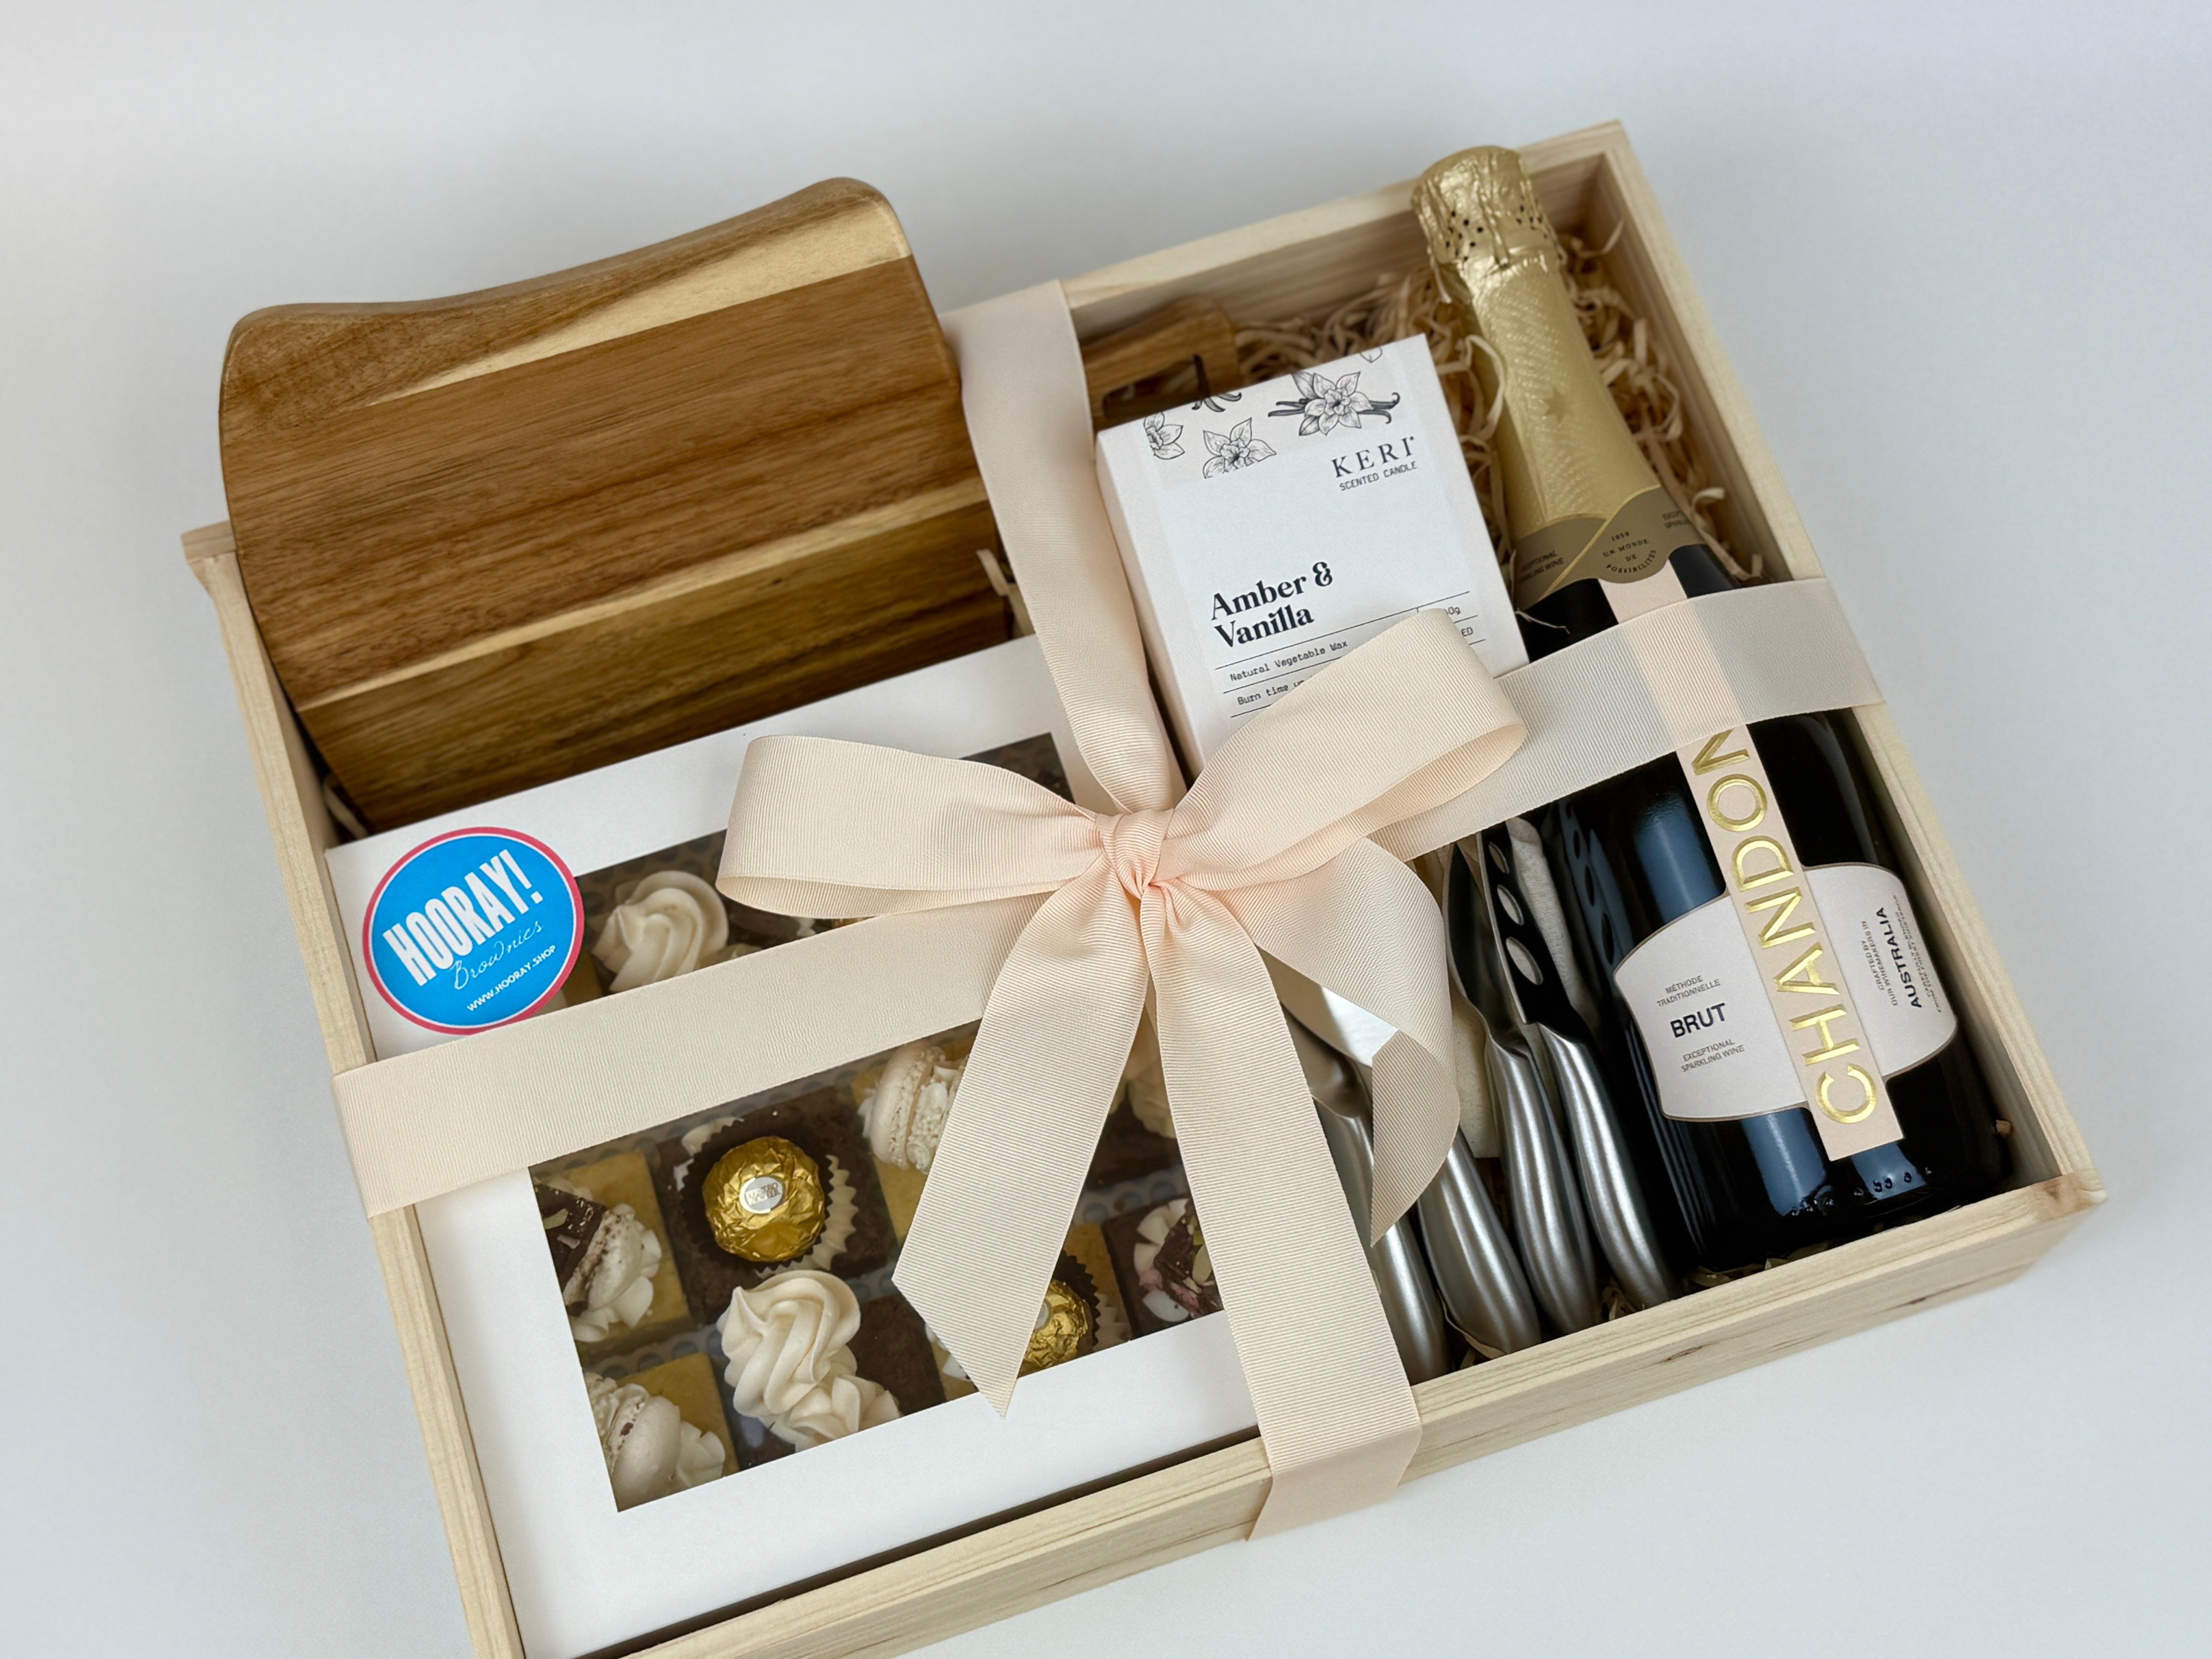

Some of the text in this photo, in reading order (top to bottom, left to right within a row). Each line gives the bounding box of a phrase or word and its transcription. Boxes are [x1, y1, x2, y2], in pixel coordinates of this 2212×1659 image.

[1339, 461, 1417, 491] SCENTED CANDLE
[1602, 539, 1649, 557] UN MONDE
[1211, 561, 1333, 621] Amber &
[1214, 604, 1314, 649] Vanilla
[1230, 641, 1348, 682] Natural Vegetable Wax
[1237, 693, 1261, 706] Burn
[1266, 685, 1289, 696] time
[383, 849, 543, 987] HOORAY!
[1692, 728, 1877, 1124] CHANDON
[449, 921, 543, 990] Brownies
[1861, 940, 1884, 991] CRAFTED BY
[1865, 931, 1891, 987] WINEMAKERS
[1876, 907, 1922, 1008] AUSTRALIA
[467, 945, 556, 1012] WWW.HOORAY.SHOP
[1657, 979, 1721, 1007] TRADITIONNELLE
[1665, 975, 1704, 994] MÉTHODE
[1887, 988, 1898, 1006] OUR
[1670, 1002, 1725, 1038] BRUT
[1681, 1044, 1745, 1072] SPARKLING WINE
[1683, 1039, 1736, 1062] EXCEPTIONAL
